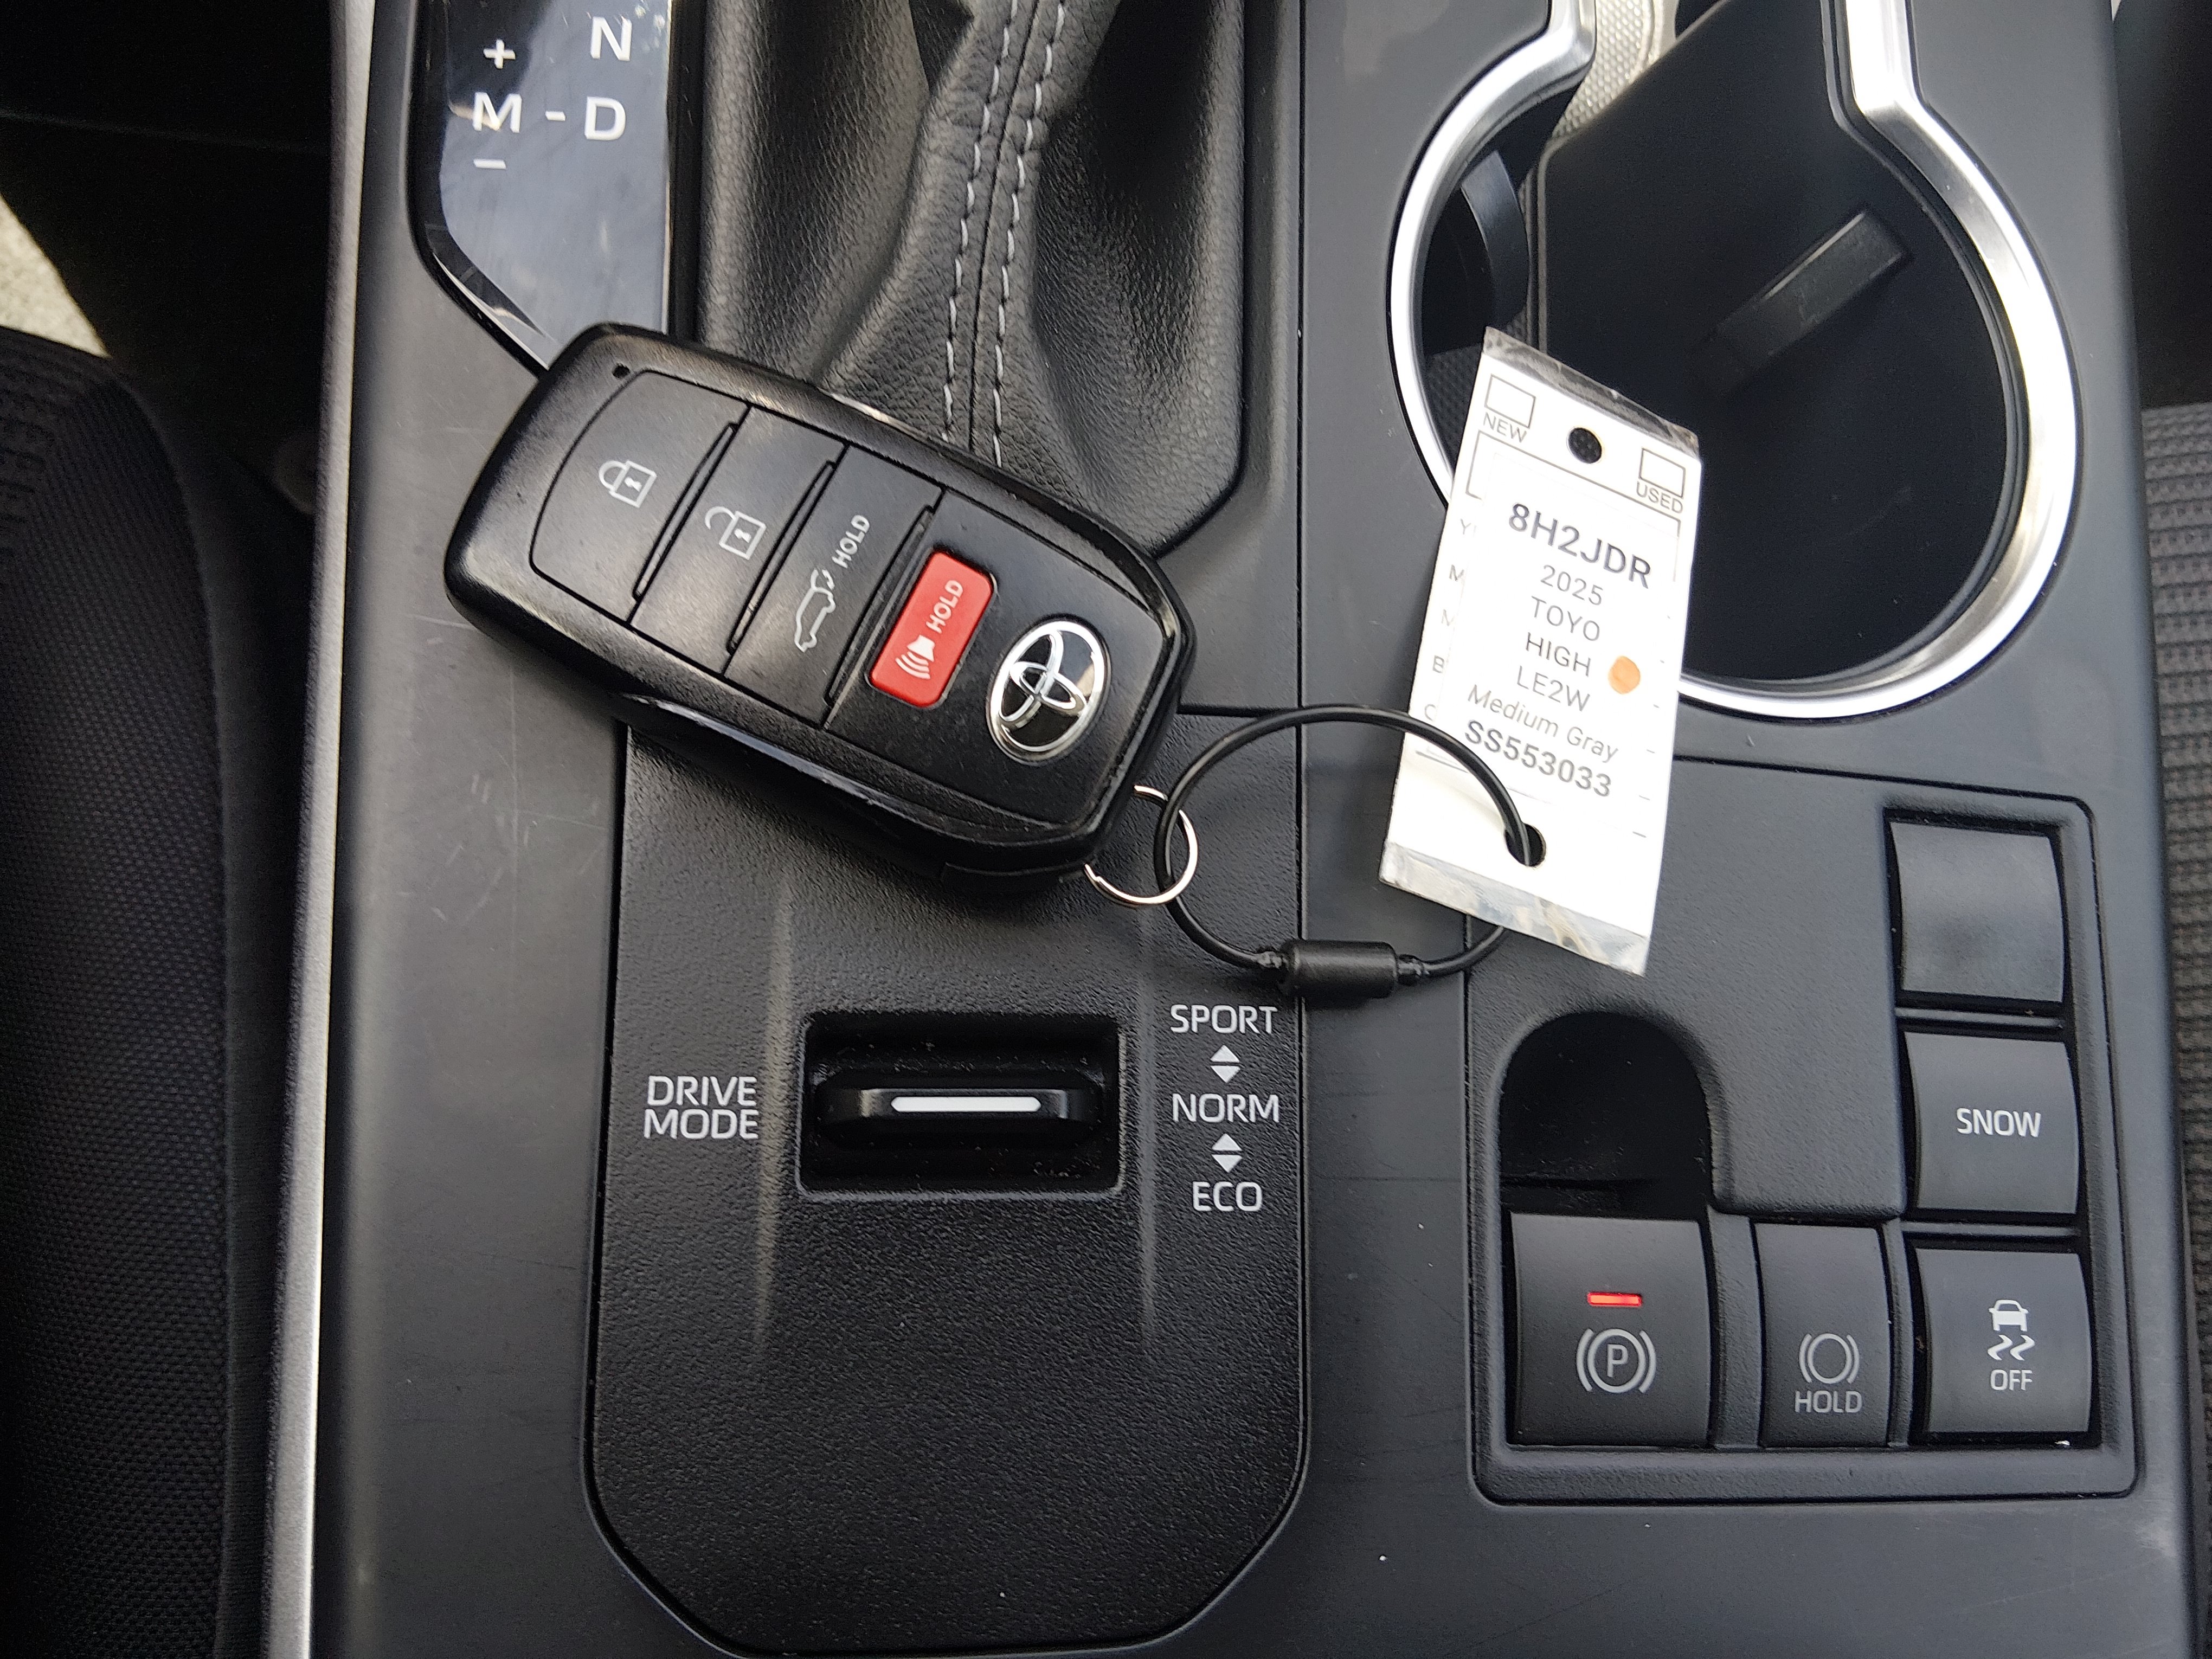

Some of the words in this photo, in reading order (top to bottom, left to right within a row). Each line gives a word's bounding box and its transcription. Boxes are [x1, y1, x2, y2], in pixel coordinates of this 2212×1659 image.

[590, 16, 632, 61] N
[472, 92, 523, 133] M
[584, 96, 627, 141] D
[1482, 412, 1528, 443] NEW
[1635, 481, 1683, 515] USED
[832, 515, 870, 569] HOLD
[1508, 502, 1652, 589] 8H2JDR
[1540, 564, 1603, 606] 2025
[926, 579, 964, 634] HOLD
[1531, 596, 1600, 642] TOYO
[1525, 632, 1592, 677] HIGH
[1516, 665, 1591, 712] LE2W
[1468, 684, 1559, 737] Medium
[1566, 726, 1619, 763] Gray
[1464, 719, 1612, 798] SS553033
[1170, 1004, 1278, 1035] SPORT
[647, 1075, 758, 1106] DRIVE
[1172, 1093, 1280, 1123] NORM
[644, 1108, 759, 1140] MODE
[1956, 1107, 2042, 1139] SNOW
[1192, 1181, 1263, 1212] ECO
[1606, 1343, 1628, 1378] P
[1989, 1369, 2034, 1392] OFF
[1795, 1390, 1863, 1414] HOLD
